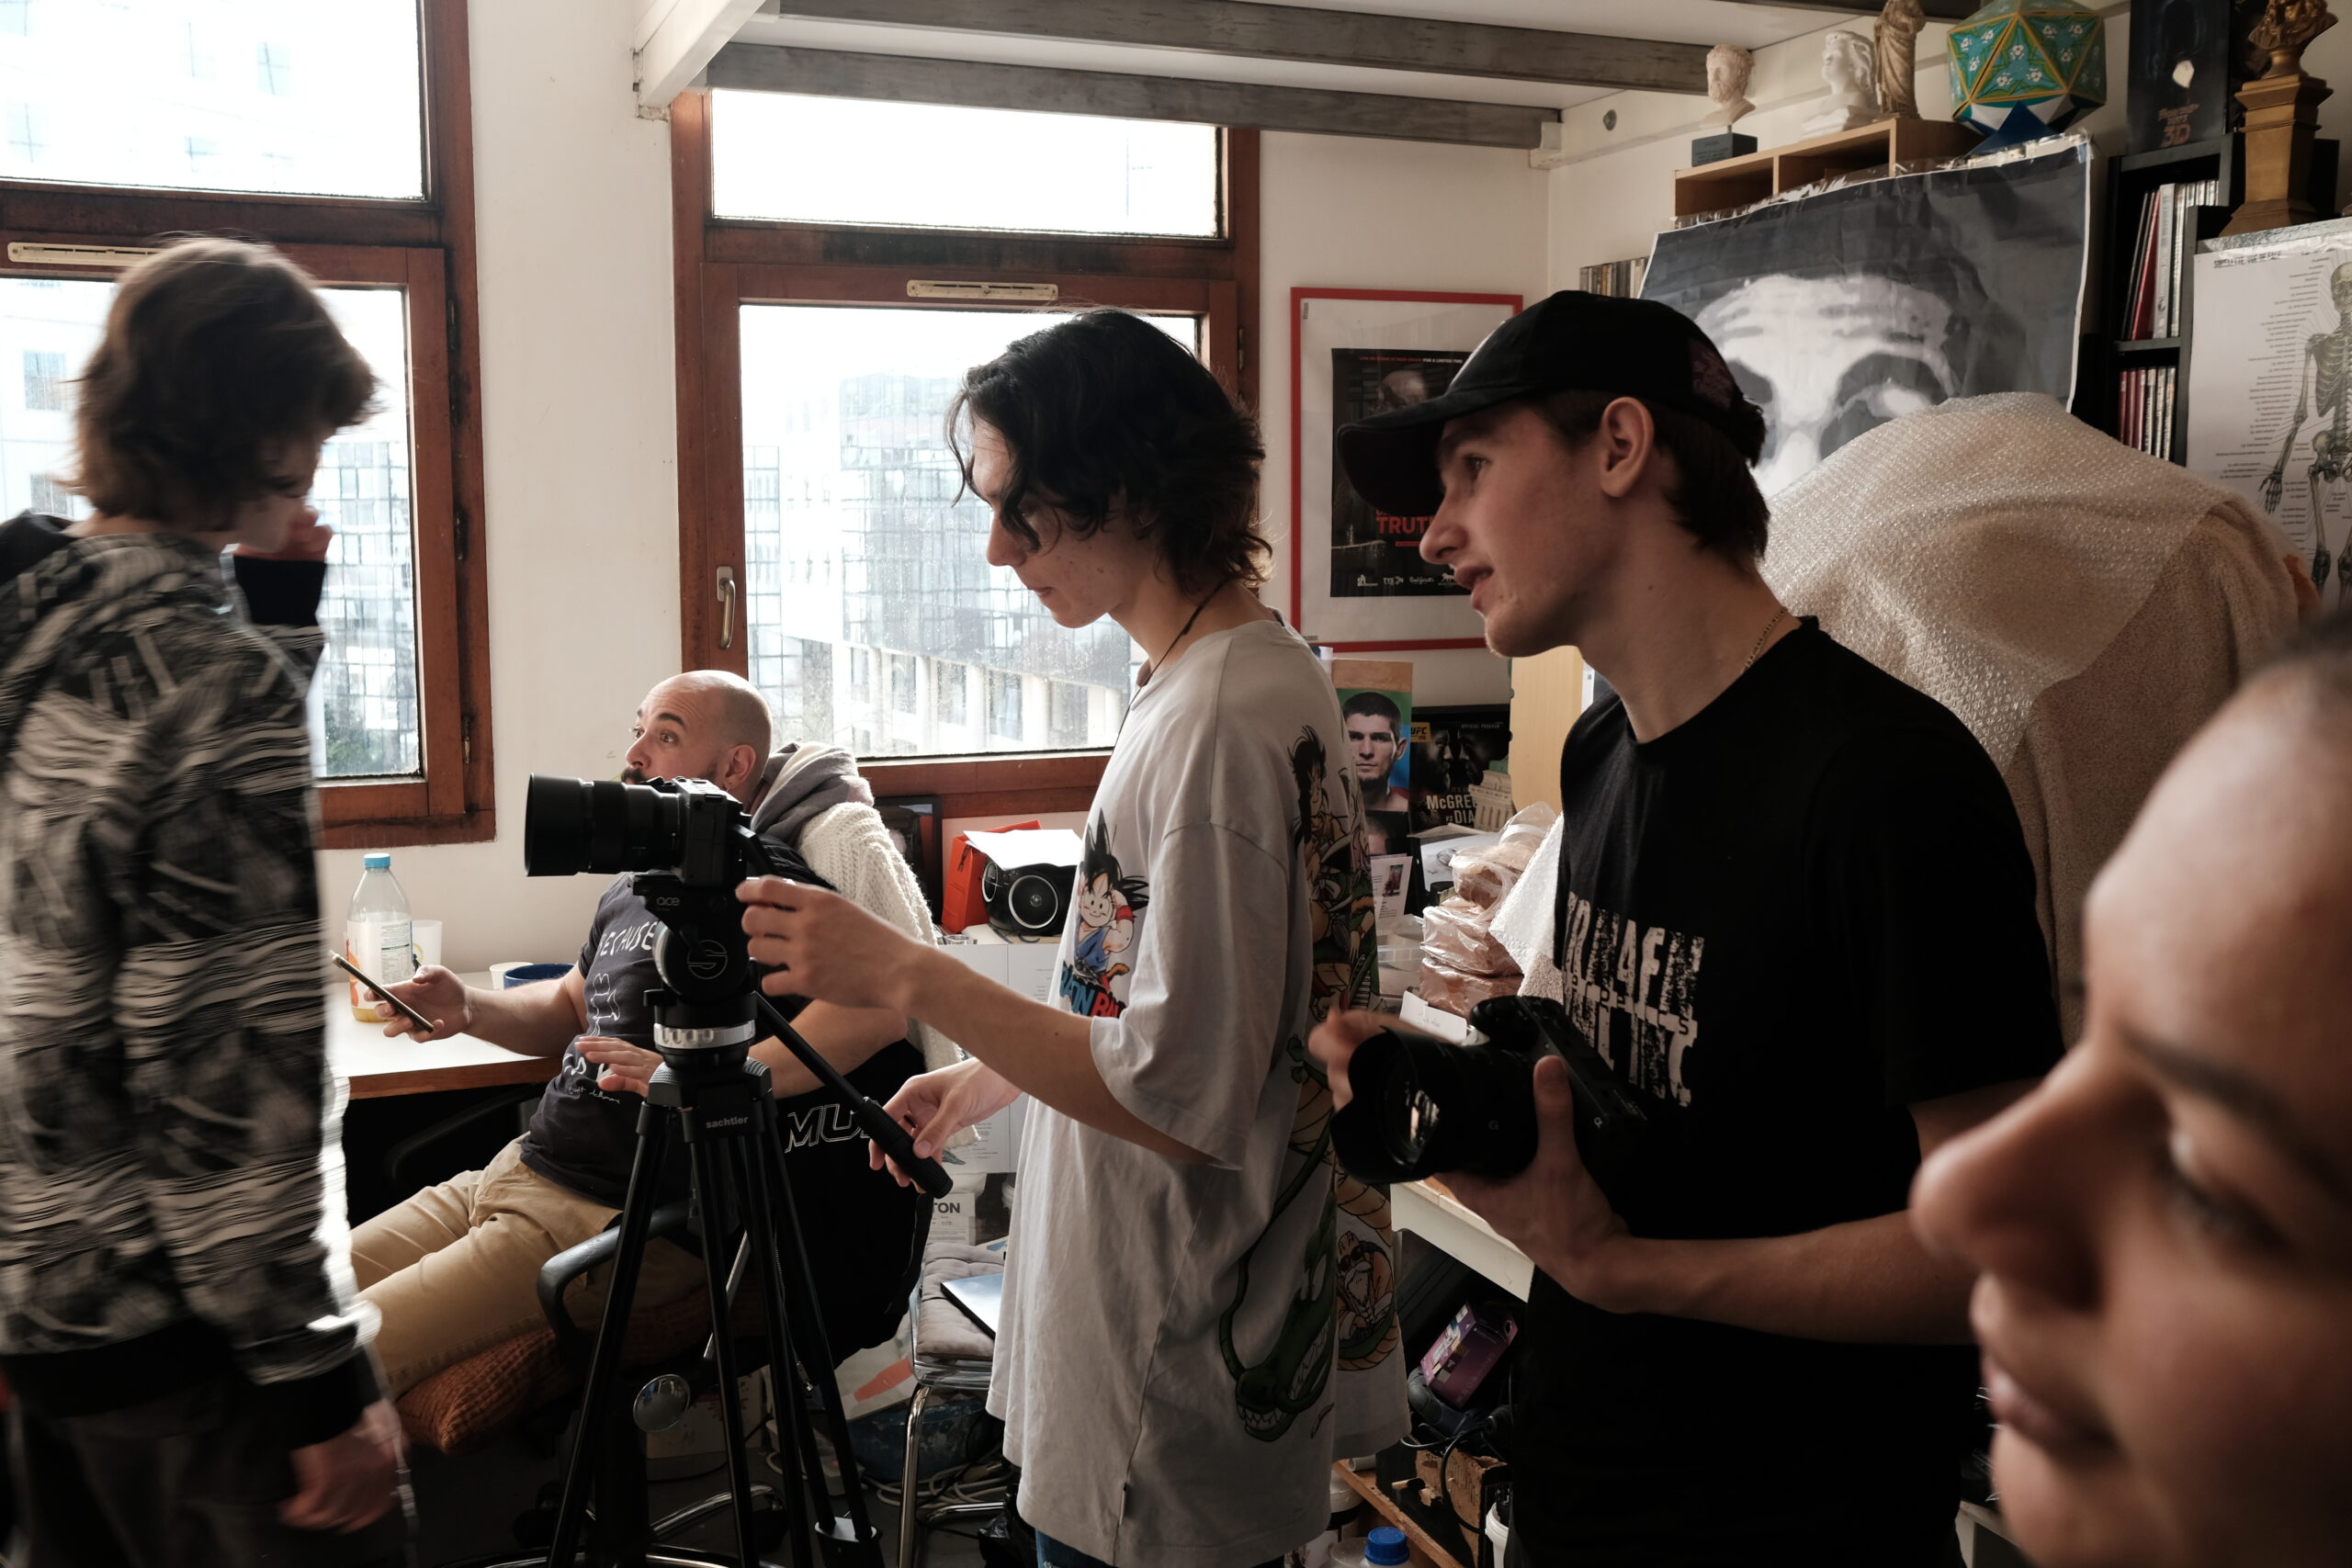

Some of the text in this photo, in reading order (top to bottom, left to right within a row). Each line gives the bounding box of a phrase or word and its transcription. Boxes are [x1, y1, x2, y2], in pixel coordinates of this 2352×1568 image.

[1453, 810, 1476, 824] DIA
[656, 897, 681, 907] ace
[706, 1115, 749, 1129] sachtler
[784, 1103, 871, 1154] MU
